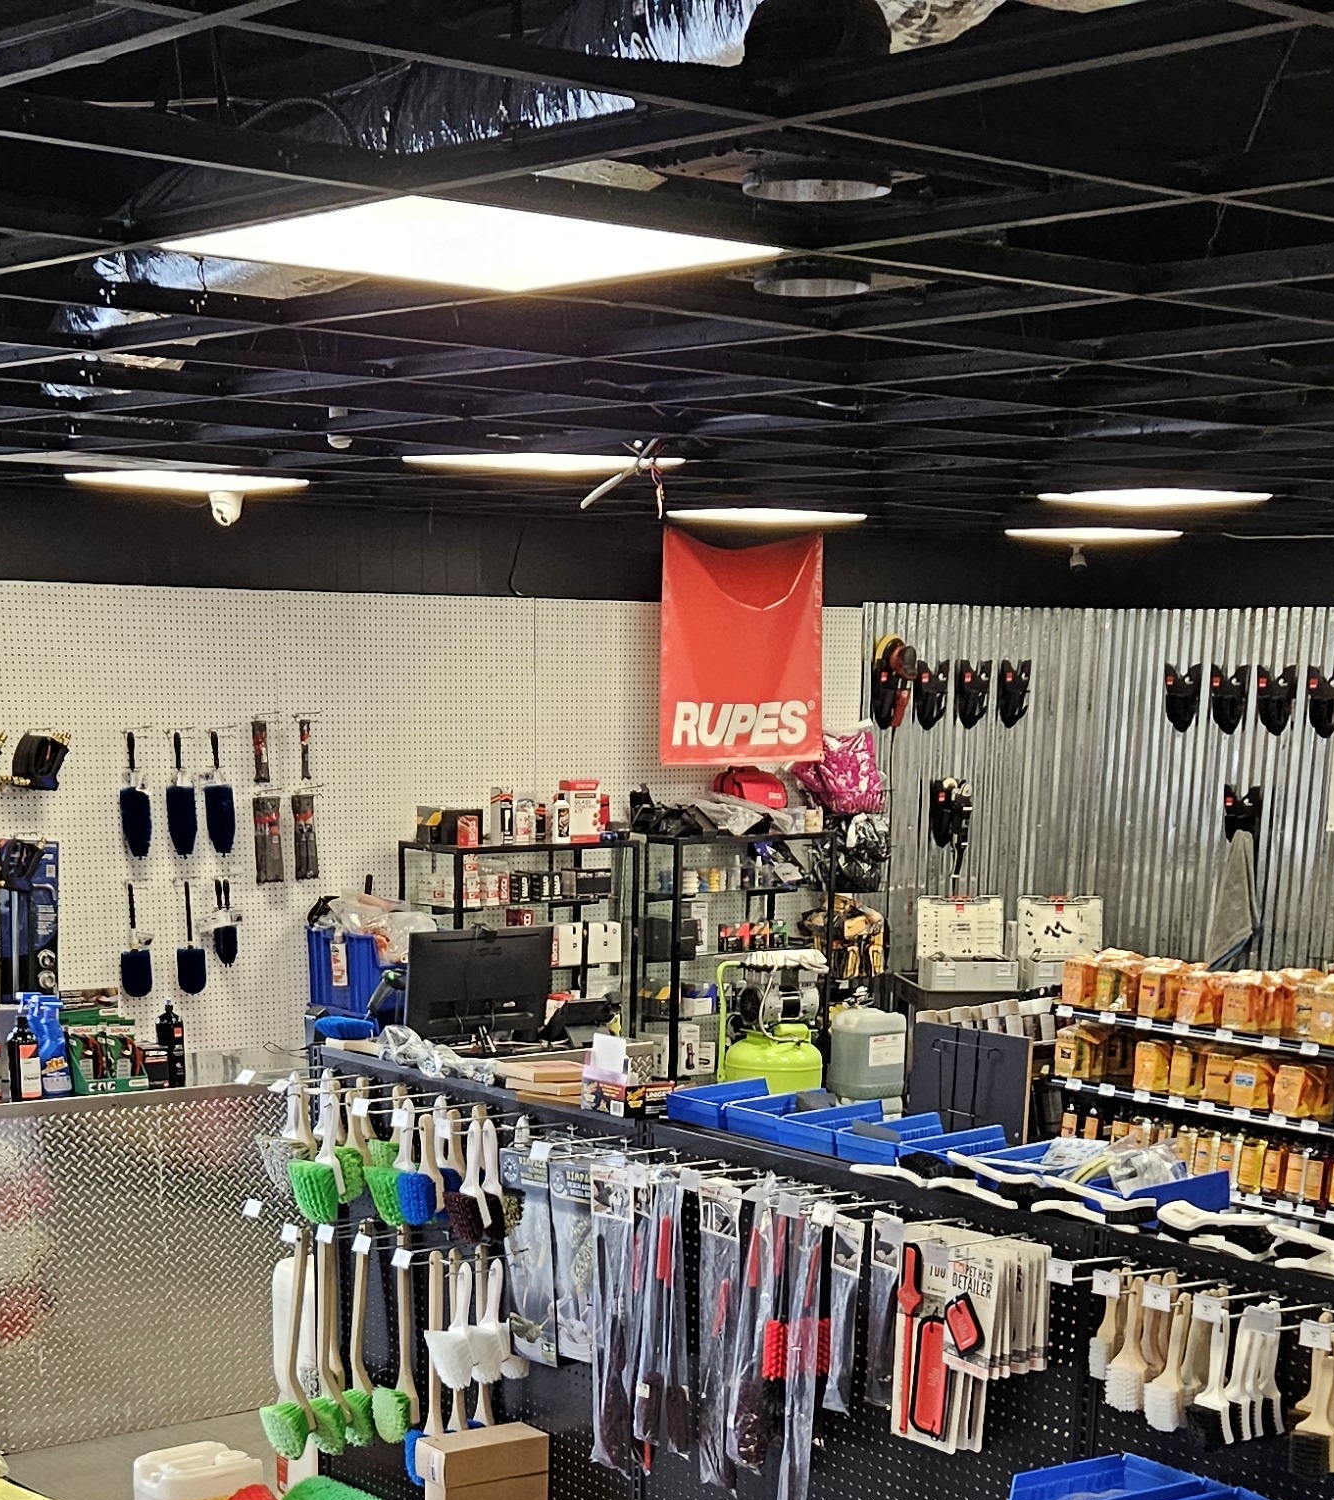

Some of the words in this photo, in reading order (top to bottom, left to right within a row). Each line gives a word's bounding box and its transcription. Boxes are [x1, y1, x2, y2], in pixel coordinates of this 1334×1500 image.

[965, 1263, 978, 1279] PET
[978, 1267, 994, 1284] HAIR
[951, 1272, 992, 1300] DETAILER
